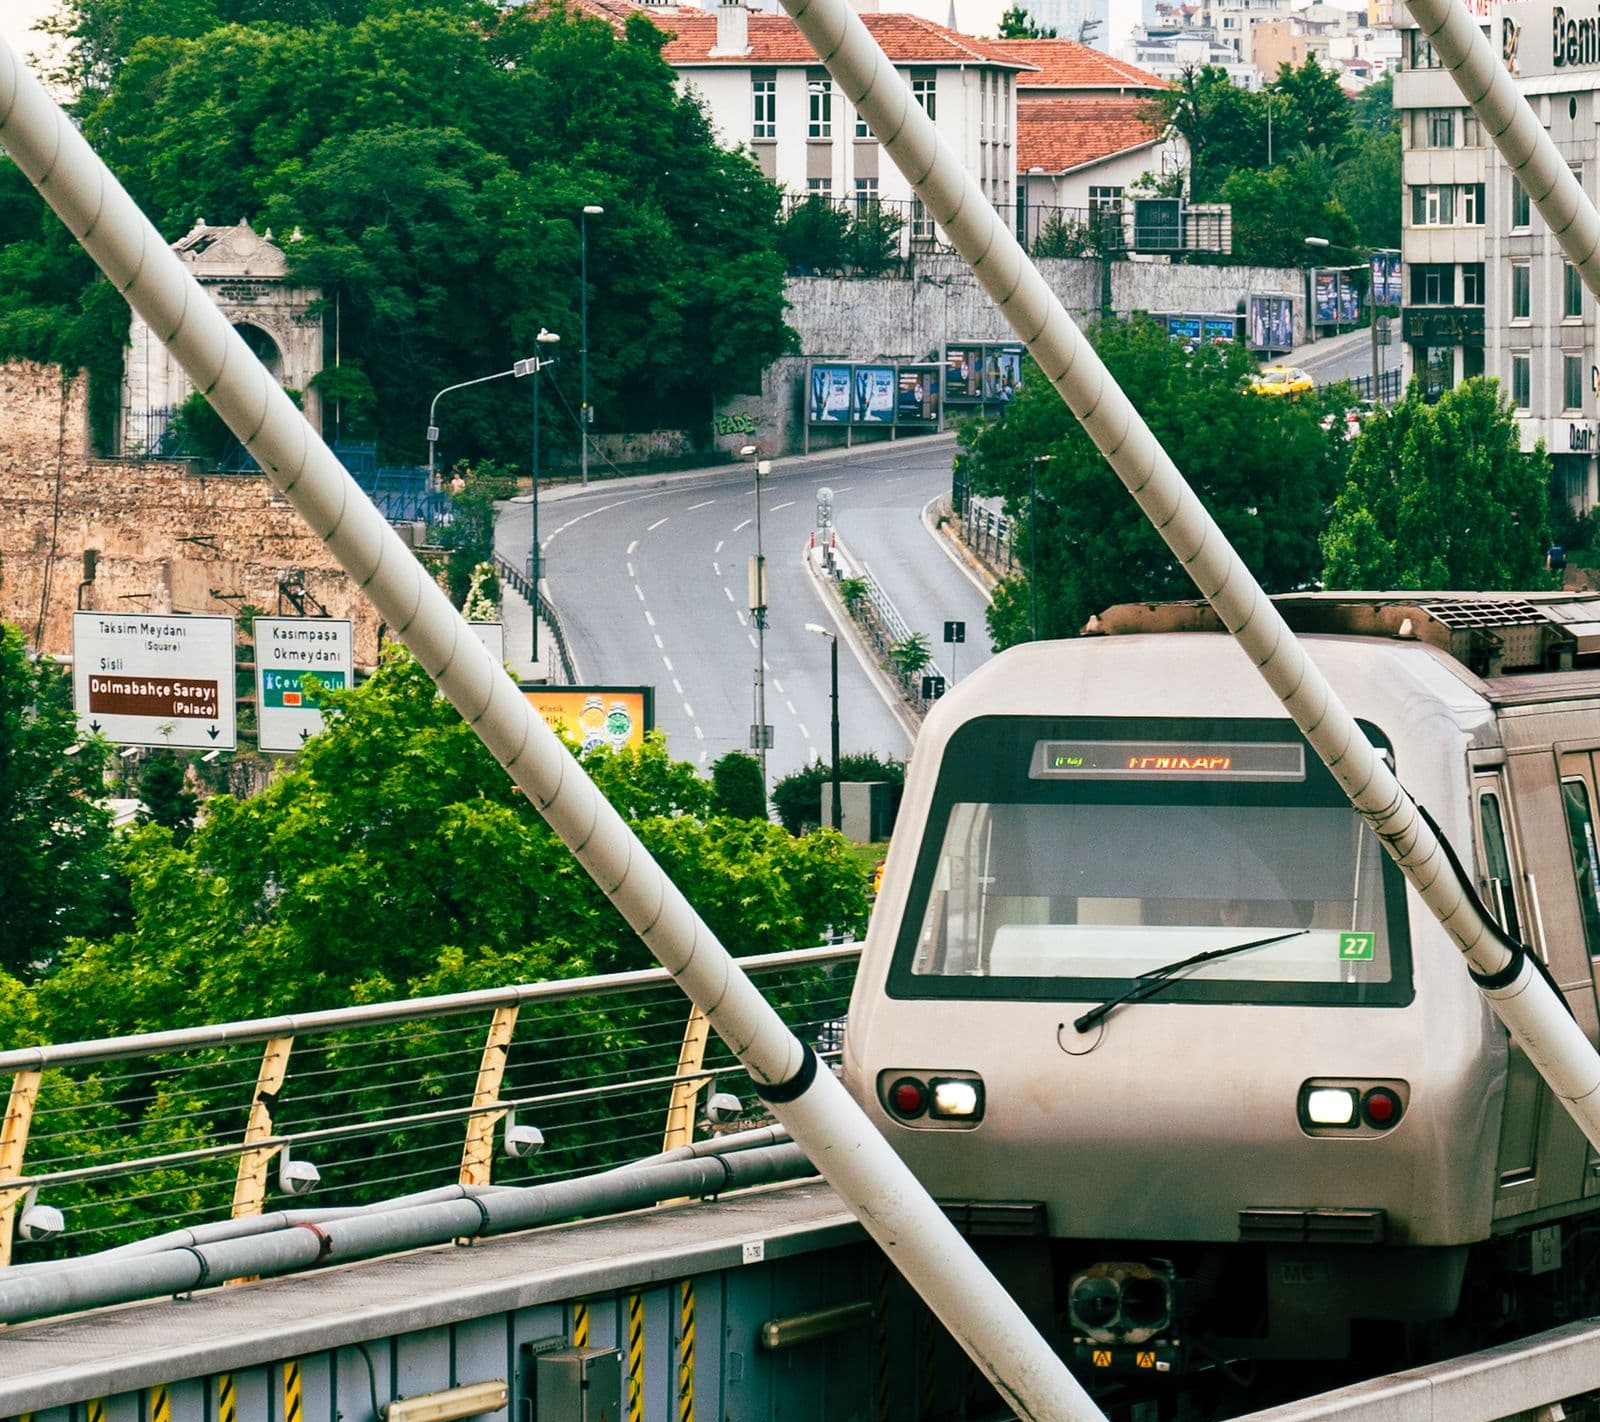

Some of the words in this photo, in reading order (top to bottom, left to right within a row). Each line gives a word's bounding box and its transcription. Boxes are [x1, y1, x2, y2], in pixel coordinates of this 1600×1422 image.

[99, 621, 137, 635] Taksim
[140, 623, 187, 638] Meydanı
[272, 627, 338, 643] Kasımpaşa
[144, 641, 181, 653] (Square)
[274, 648, 341, 664] Okmeydanı
[91, 679, 171, 698] Dolmabahçe
[173, 682, 216, 701] Sarayı
[172, 701, 216, 717] (Palace)
[1344, 938, 1369, 955] 27
